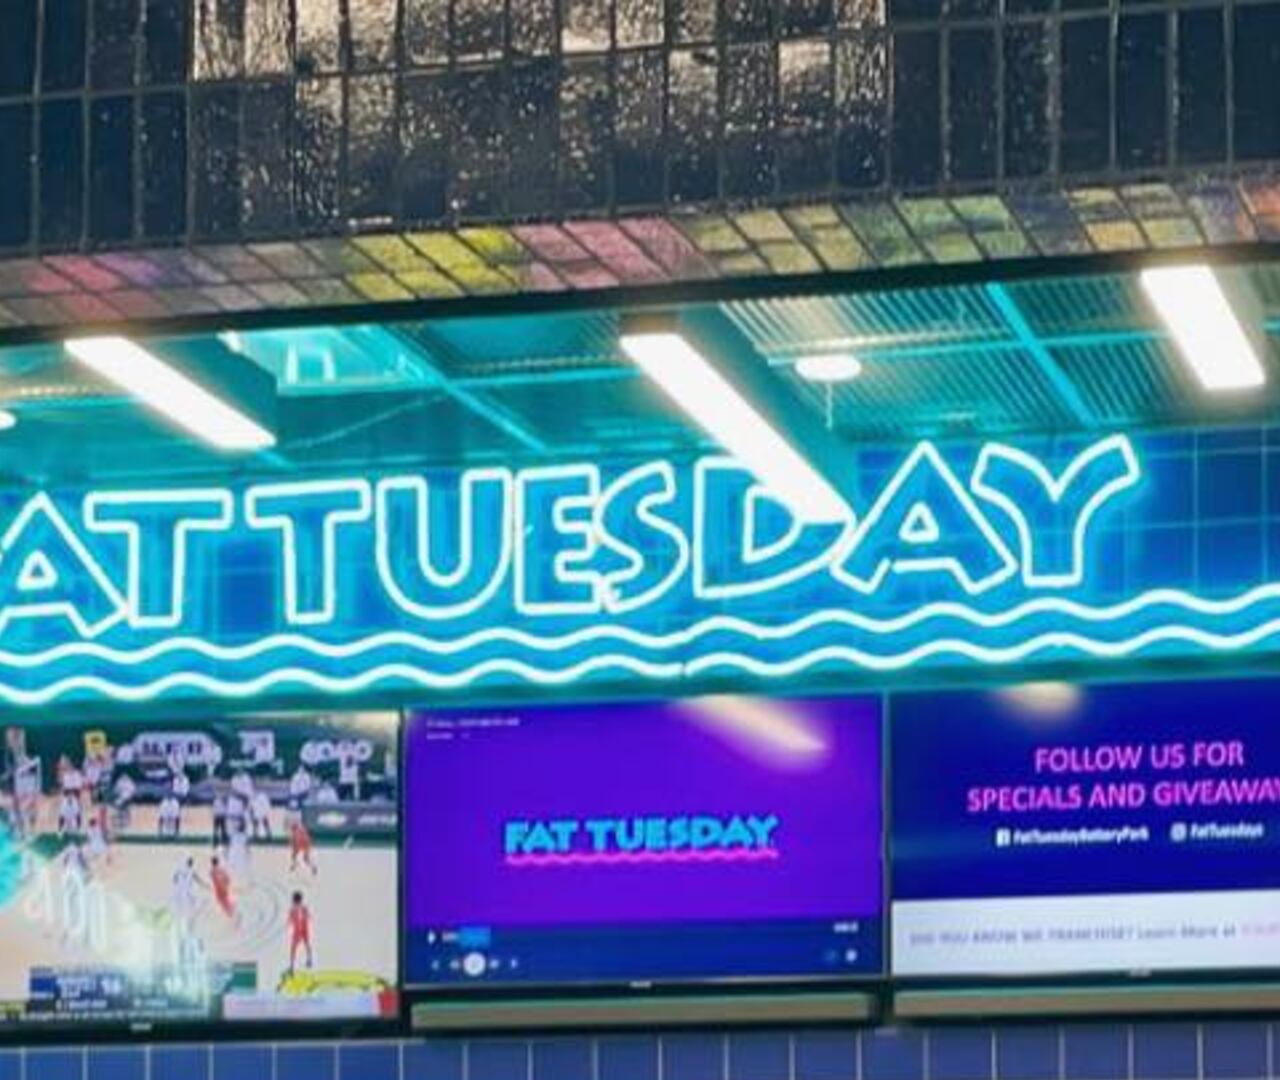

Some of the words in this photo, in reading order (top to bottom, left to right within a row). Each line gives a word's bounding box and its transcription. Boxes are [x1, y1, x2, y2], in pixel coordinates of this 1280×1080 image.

[245, 434, 1140, 624] TUESDAY
[1034, 746, 1142, 773] FOLLOW
[1150, 744, 1185, 768] US
[1193, 741, 1244, 766] FOR
[967, 785, 1081, 812] SPECIALS
[1088, 782, 1146, 809] AND
[506, 821, 579, 853] FAT
[585, 815, 778, 850] TUESDAY
